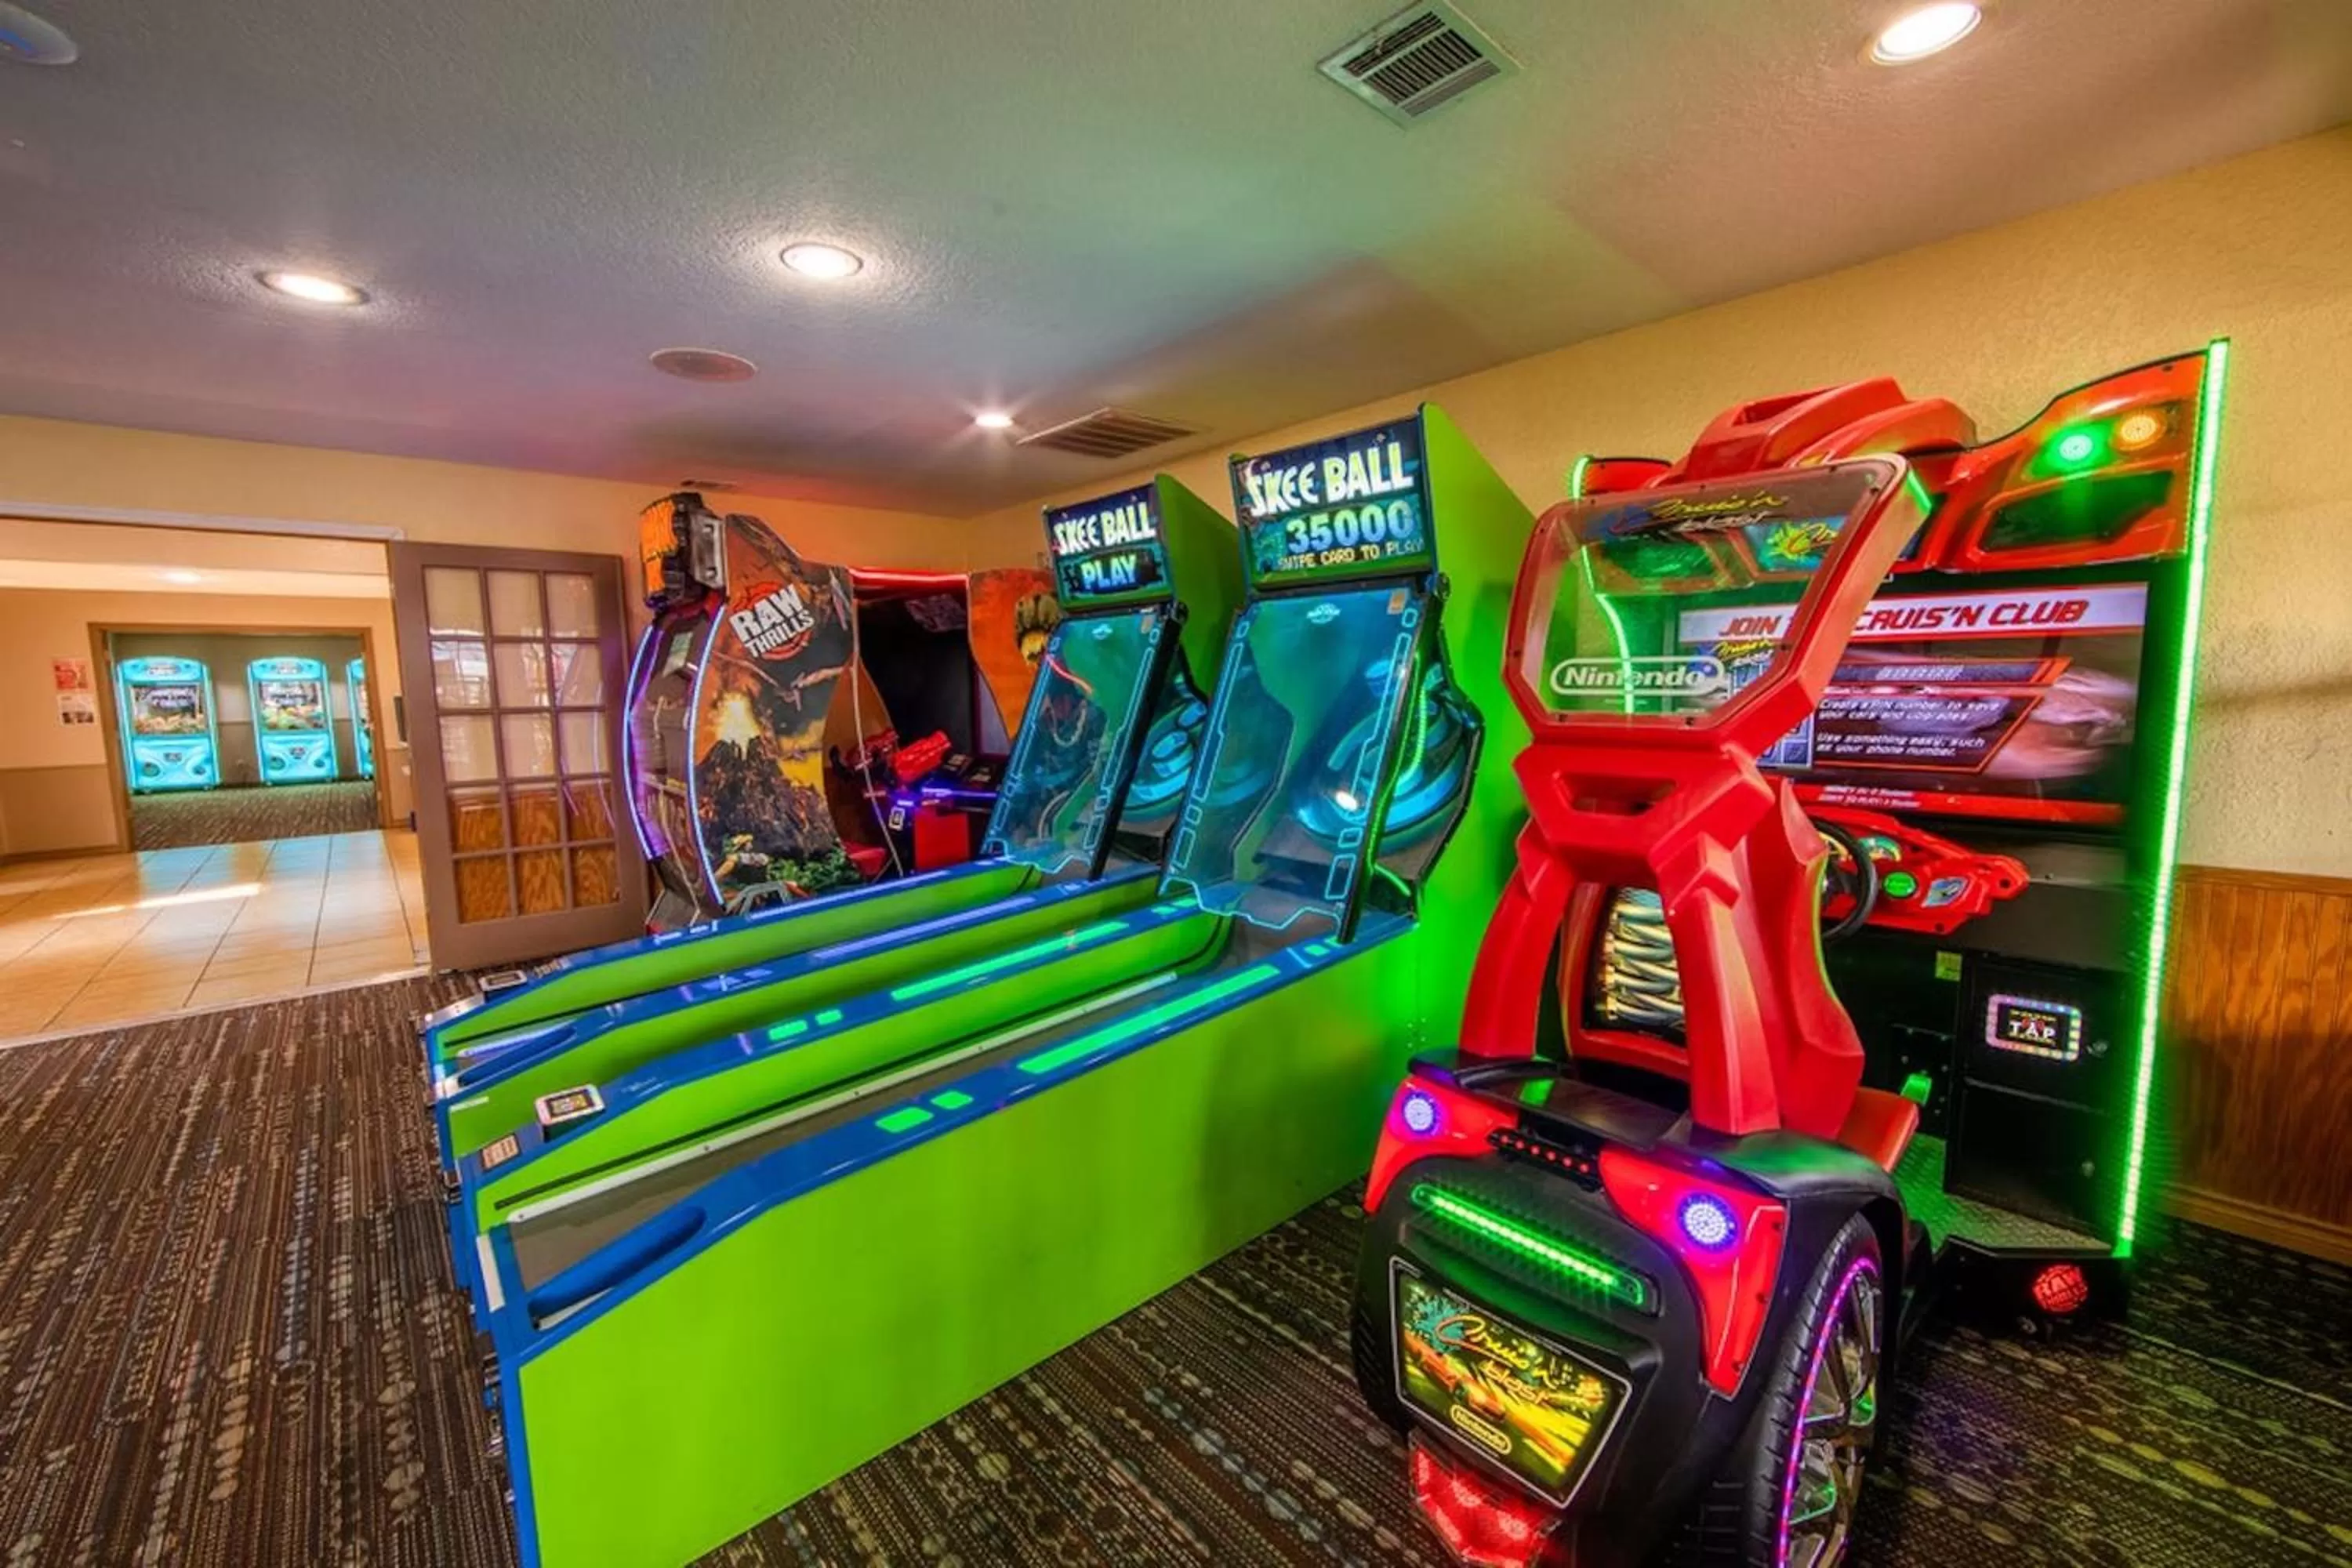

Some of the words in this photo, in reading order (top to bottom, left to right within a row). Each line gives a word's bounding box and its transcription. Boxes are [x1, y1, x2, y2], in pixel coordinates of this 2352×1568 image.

[1246, 463, 1319, 517] SKEE
[1323, 442, 1414, 503] BALL
[1054, 514, 1101, 555] SKEE
[1100, 501, 1157, 546] BALL
[1287, 499, 1414, 554] 35000
[1080, 554, 1137, 590] PLAY
[1277, 553, 1316, 572] SWIPE
[1320, 547, 1356, 565] CARD
[1359, 543, 1381, 561] TO
[1385, 538, 1426, 556] PLAY
[729, 583, 804, 644] RAW
[744, 609, 815, 659] THRILLS
[1718, 615, 1783, 637] JOIN
[1987, 599, 2090, 626] CLUB
[1563, 665, 1715, 687] Nintendo
[2009, 1020, 2056, 1040] TAP
